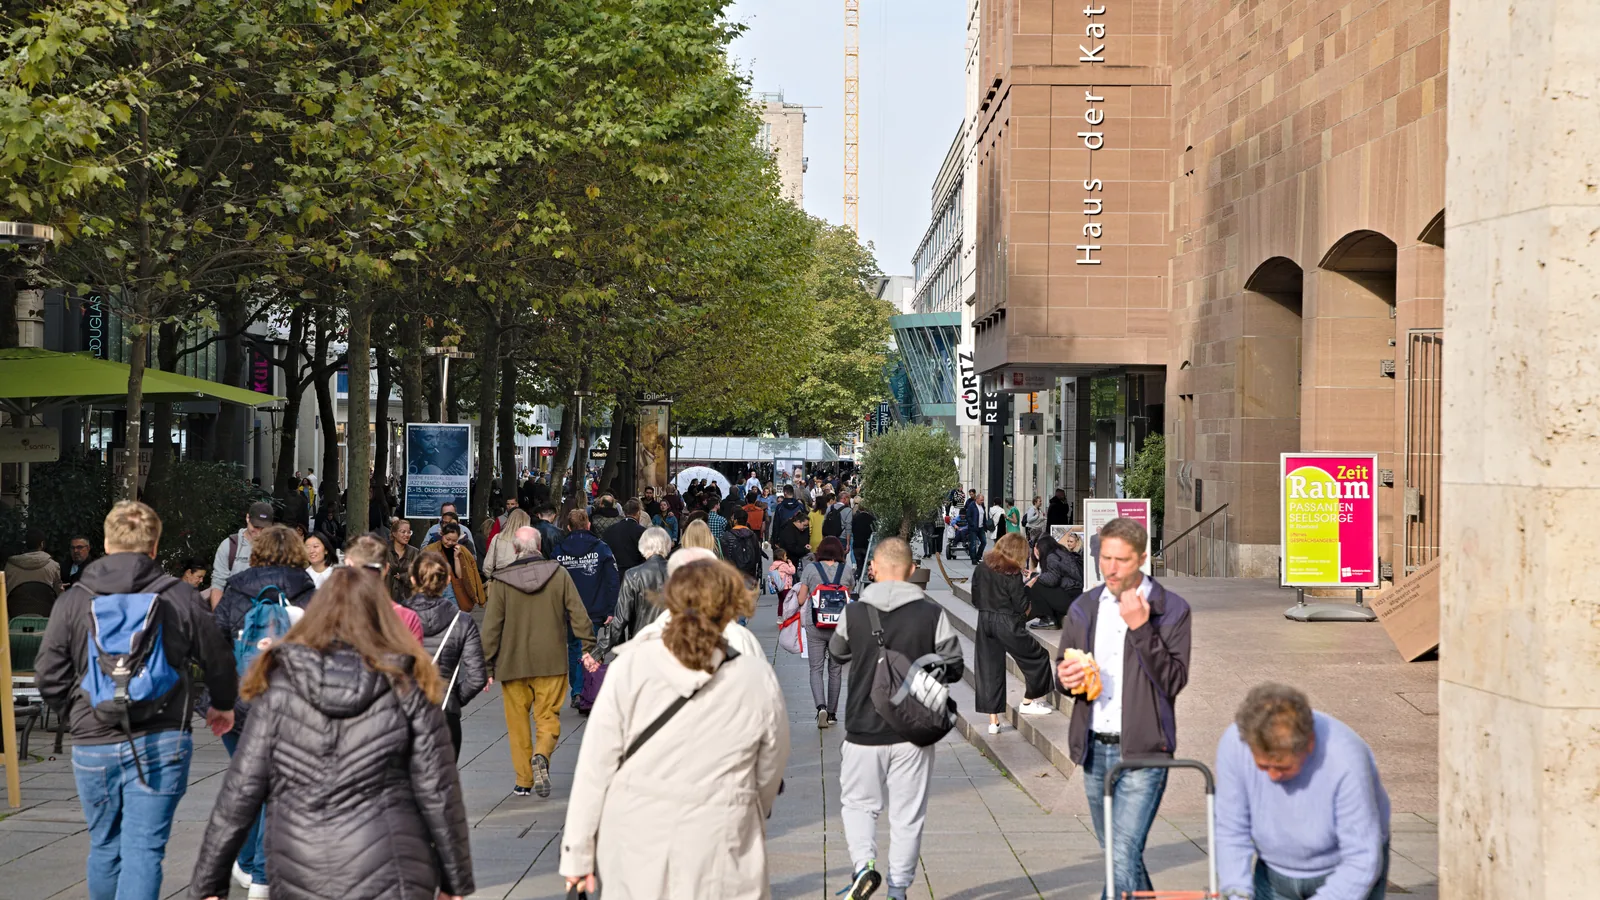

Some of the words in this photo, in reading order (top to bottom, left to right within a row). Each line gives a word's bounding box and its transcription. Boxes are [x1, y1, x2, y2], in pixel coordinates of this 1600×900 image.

[1077, 91, 1104, 150] der
[1076, 178, 1103, 265] Haus
[89, 295, 102, 357] DOUGLAS
[1337, 465, 1369, 479] Zeit
[1289, 475, 1370, 499] Raum
[1289, 502, 1353, 512] PASSANTEN
[1289, 513, 1353, 523] SEELSORGE
